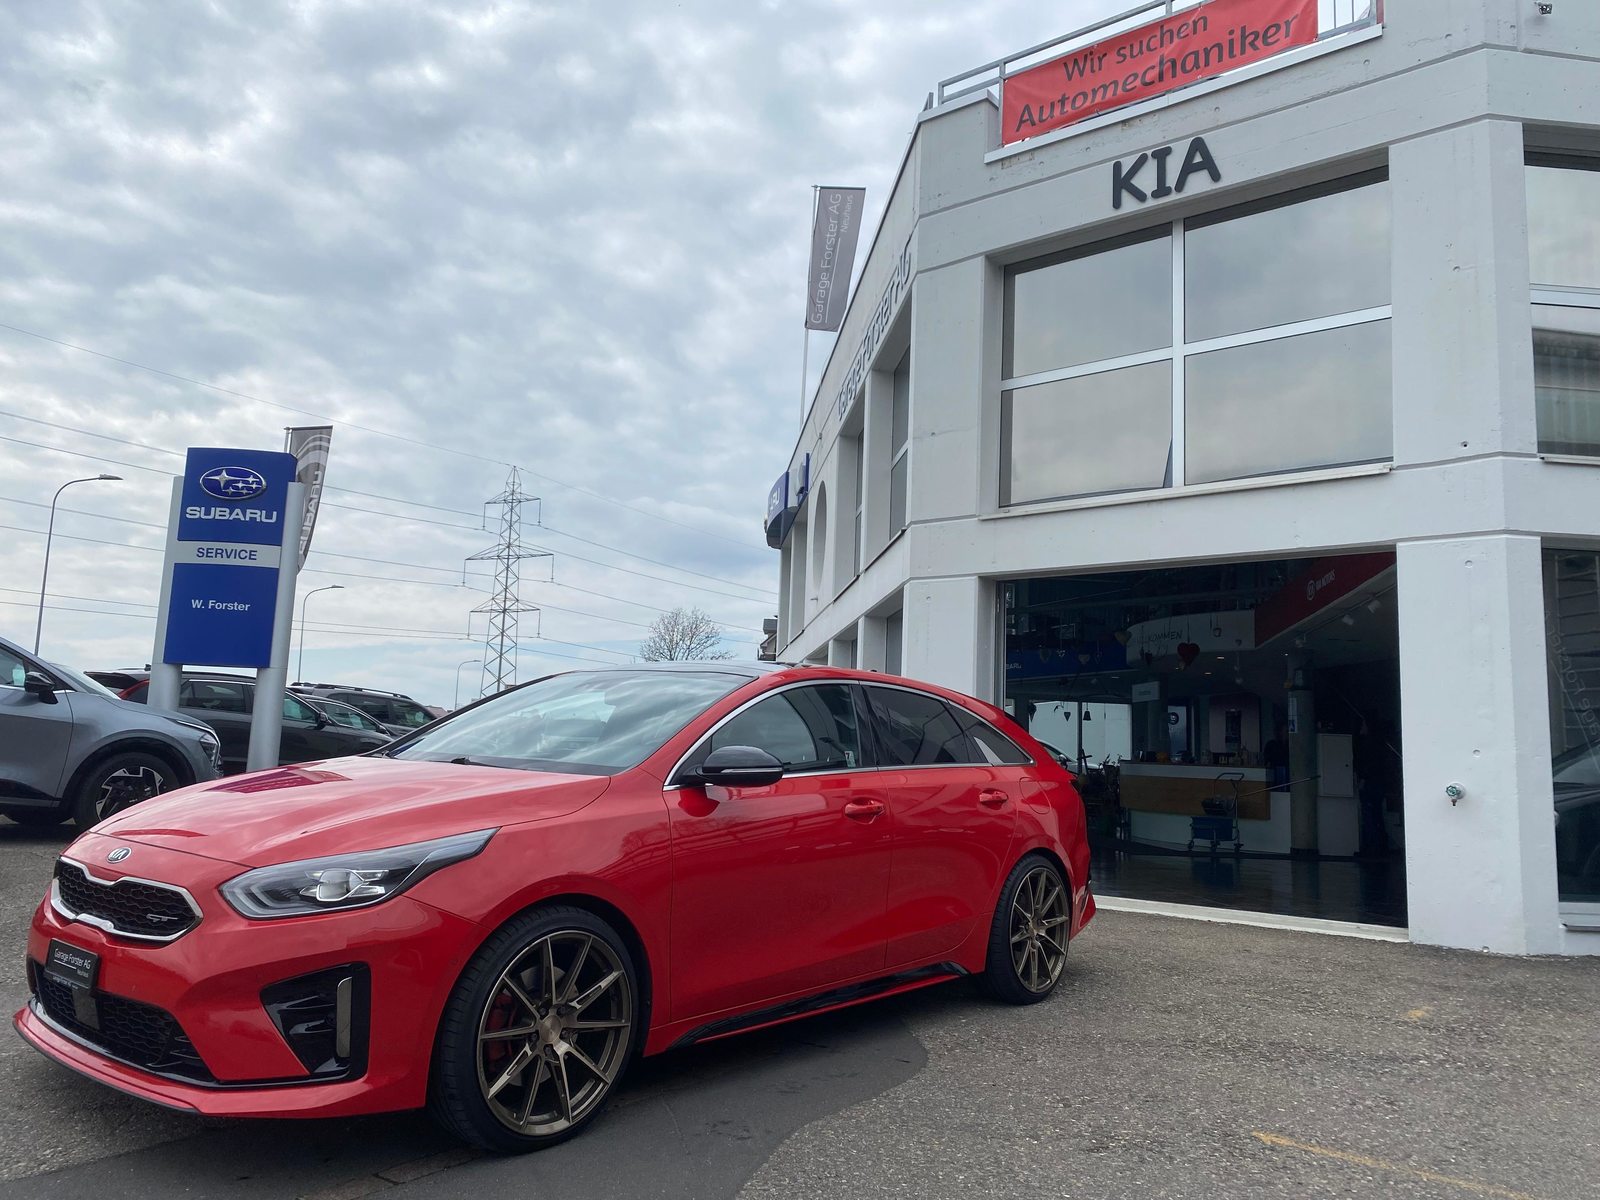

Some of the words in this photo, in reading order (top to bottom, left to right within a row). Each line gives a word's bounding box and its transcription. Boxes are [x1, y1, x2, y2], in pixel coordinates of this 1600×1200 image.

[1063, 51, 1107, 81] Wir
[1116, 14, 1208, 64] suchen
[1015, 14, 1298, 132] Automechaniker
[1112, 136, 1221, 209] KIA
[829, 193, 841, 215] AG
[841, 194, 854, 232] Neuhaus
[820, 217, 838, 268] Forster
[811, 272, 830, 324] Garage
[185, 506, 277, 523] SUBARU
[196, 547, 258, 561] SERVICE
[191, 599, 205, 609] W.
[208, 600, 251, 611] Forster
[54, 948, 69, 962] Garage
[69, 953, 84, 967] Forster
